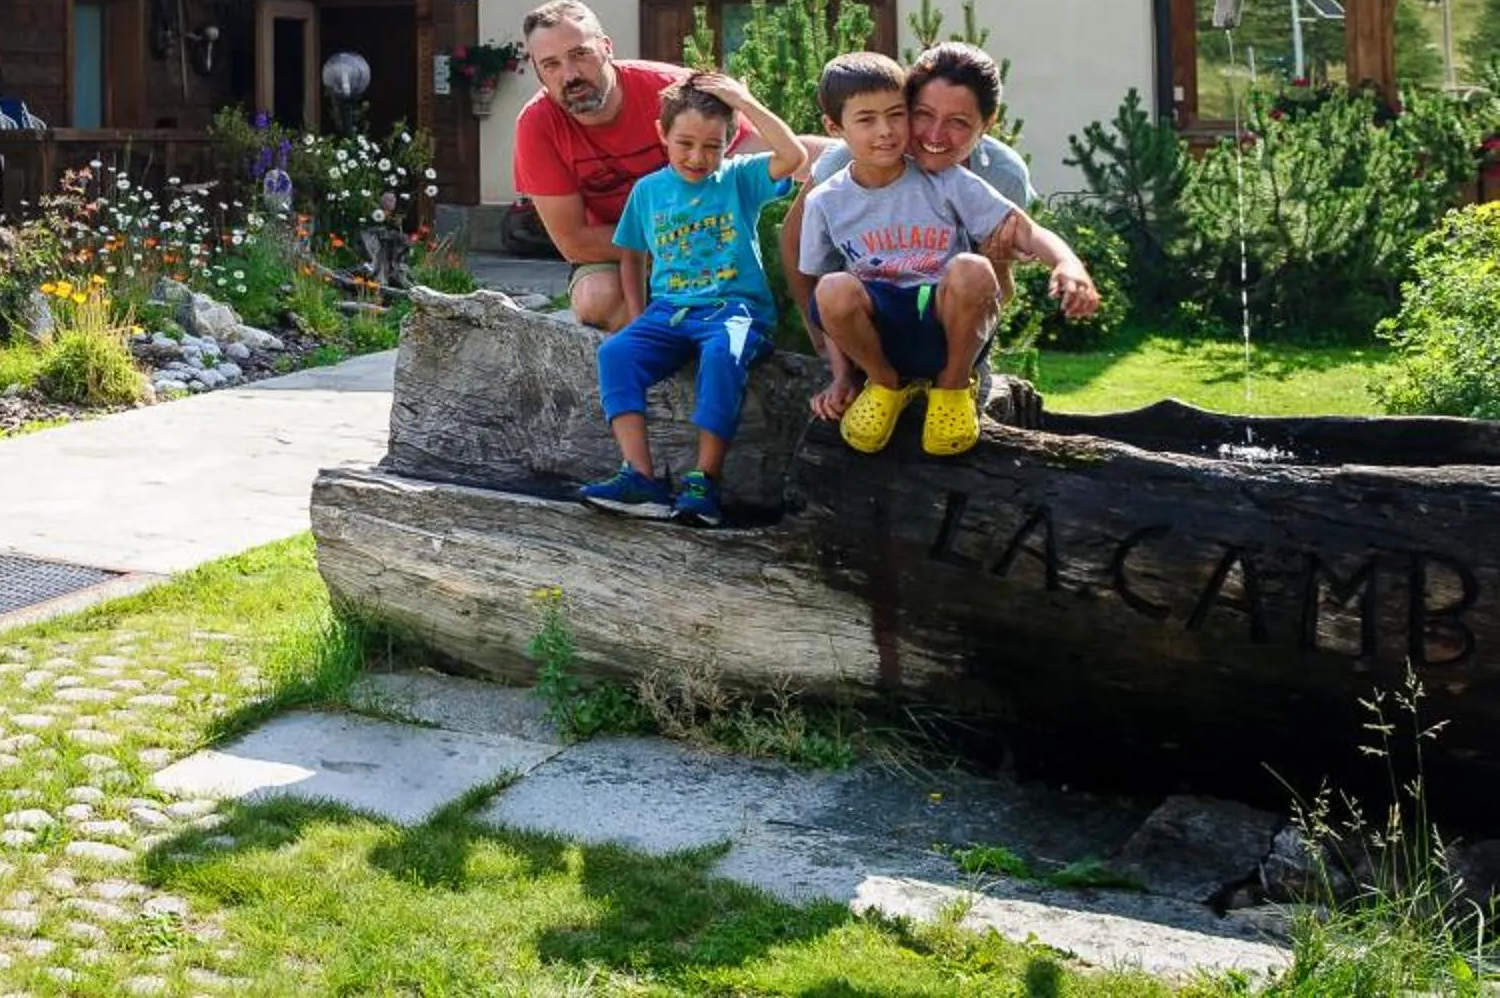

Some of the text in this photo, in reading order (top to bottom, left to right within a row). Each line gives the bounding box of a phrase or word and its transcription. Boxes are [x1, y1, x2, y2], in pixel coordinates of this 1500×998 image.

[860, 224, 950, 254] VILLAGE
[929, 490, 1479, 664] LA CAMB
